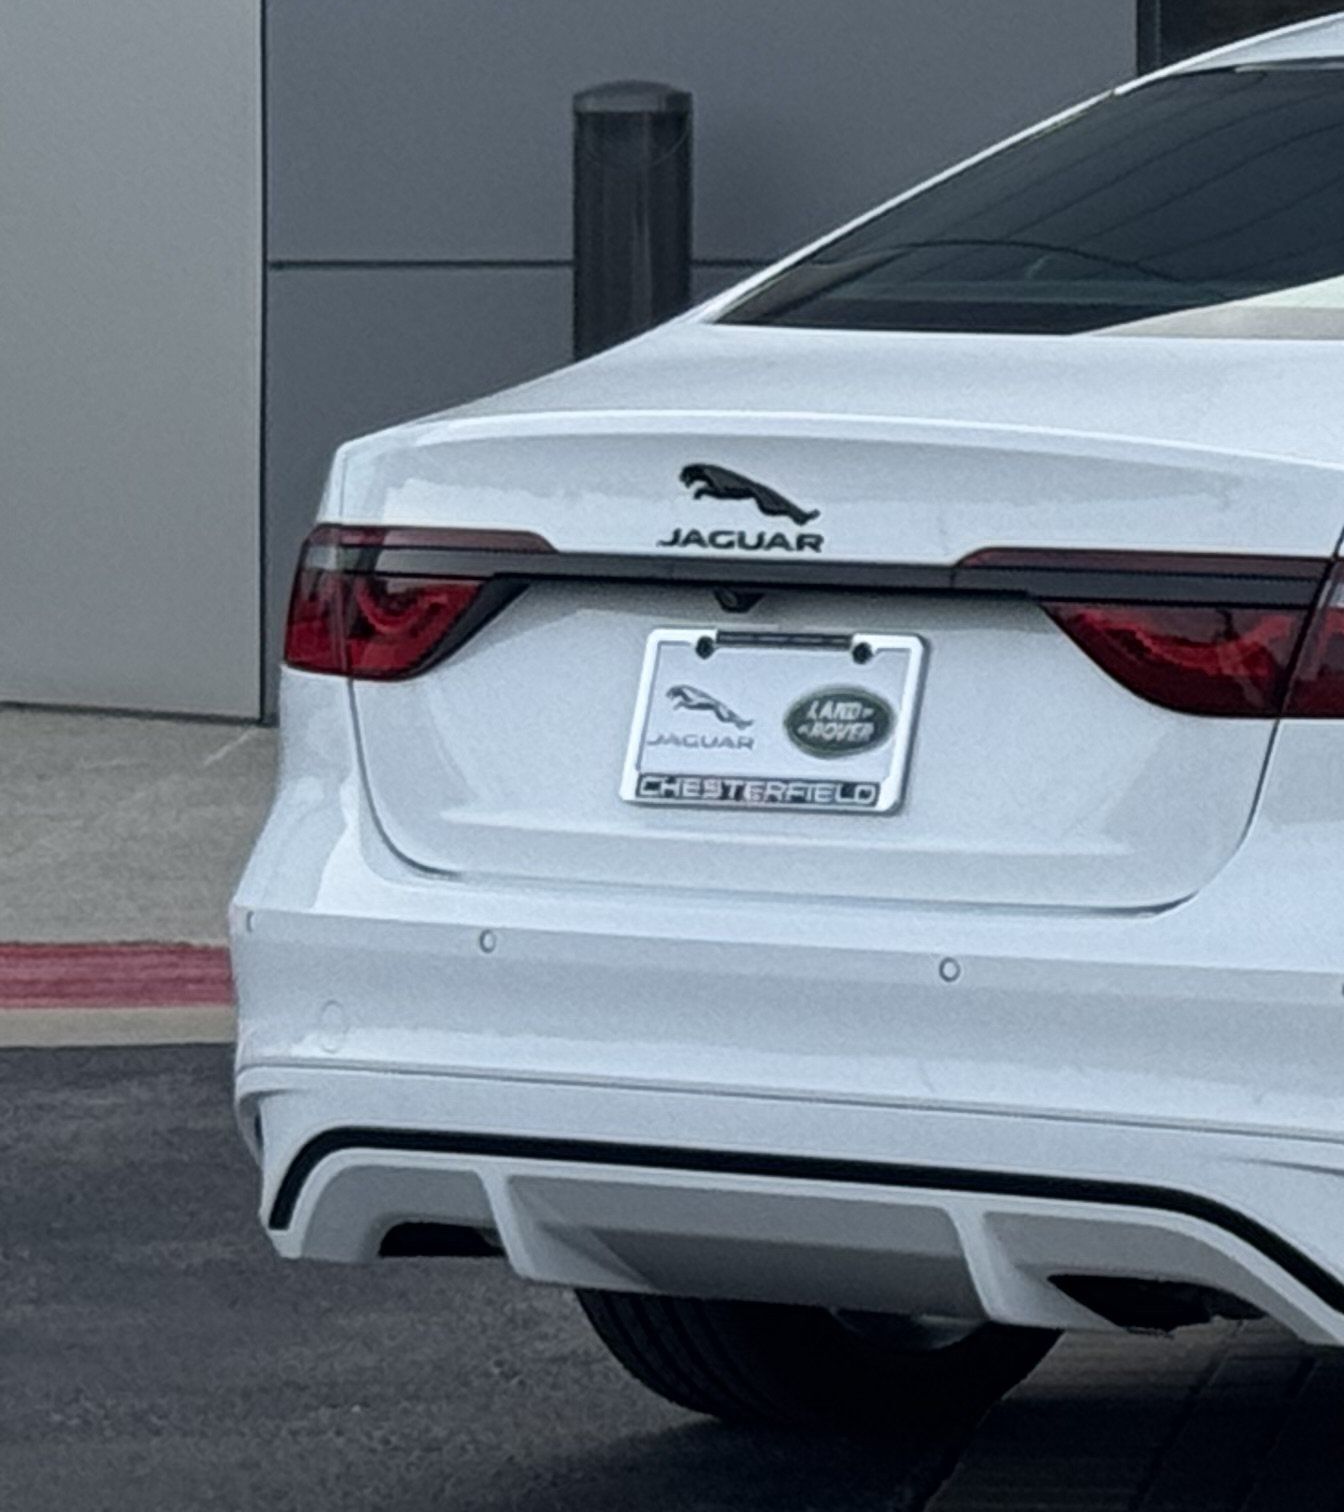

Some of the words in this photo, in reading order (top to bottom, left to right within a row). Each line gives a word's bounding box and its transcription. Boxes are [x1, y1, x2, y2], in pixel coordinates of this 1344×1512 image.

[658, 528, 824, 553] JAGUAR
[806, 699, 864, 721] LAND
[647, 733, 755, 750] JAGUAR
[808, 721, 875, 743] ROVER
[639, 776, 876, 805] CHESTERFIELD
